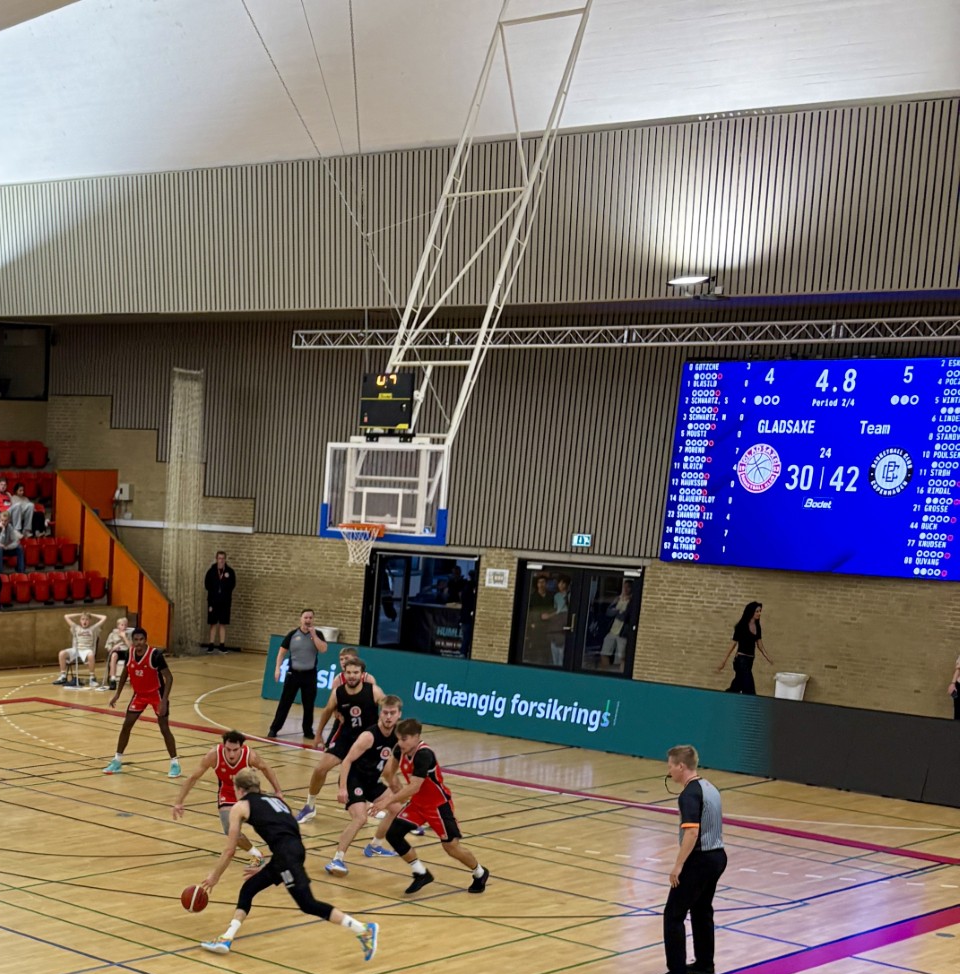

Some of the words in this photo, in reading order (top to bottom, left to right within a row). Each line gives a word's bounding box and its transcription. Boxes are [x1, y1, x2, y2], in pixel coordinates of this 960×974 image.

[764, 368, 774, 384] 4
[816, 368, 857, 392] 4.8
[903, 366, 914, 383] 5
[812, 398, 838, 407] Period
[842, 398, 855, 407] 2/4
[758, 420, 816, 434] GLADSAXE
[860, 420, 891, 434] Team
[820, 448, 832, 458] 24
[785, 464, 814, 491] 30
[829, 466, 860, 492] 42
[804, 498, 832, 508] Bodet
[918, 540, 946, 548] KNUDSEN
[414, 680, 507, 718] Uafhængig
[351, 716, 362, 728] 21
